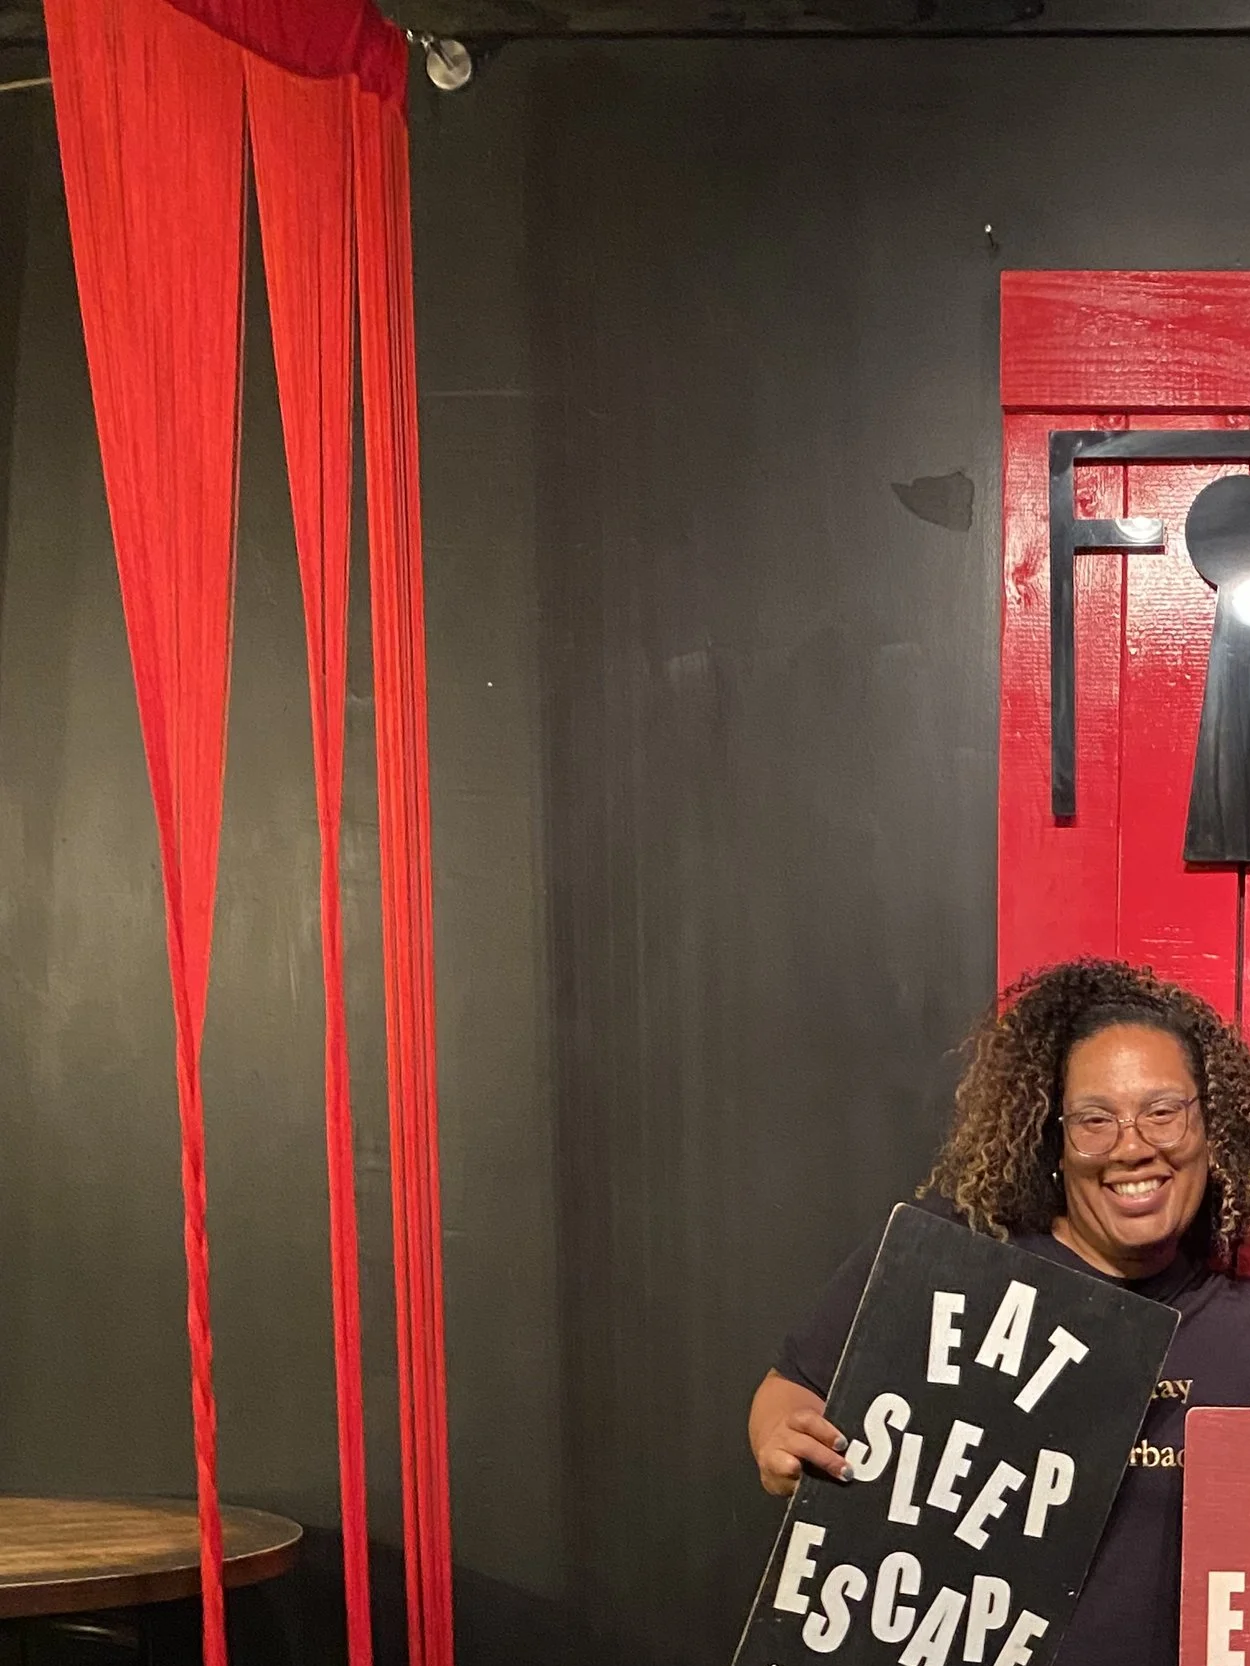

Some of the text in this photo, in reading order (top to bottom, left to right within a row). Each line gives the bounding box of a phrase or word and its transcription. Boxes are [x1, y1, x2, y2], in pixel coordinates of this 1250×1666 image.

[926, 1279, 1090, 1413] EAT
[1151, 1378, 1194, 1404] ay
[846, 1392, 1076, 1550] SLEEP
